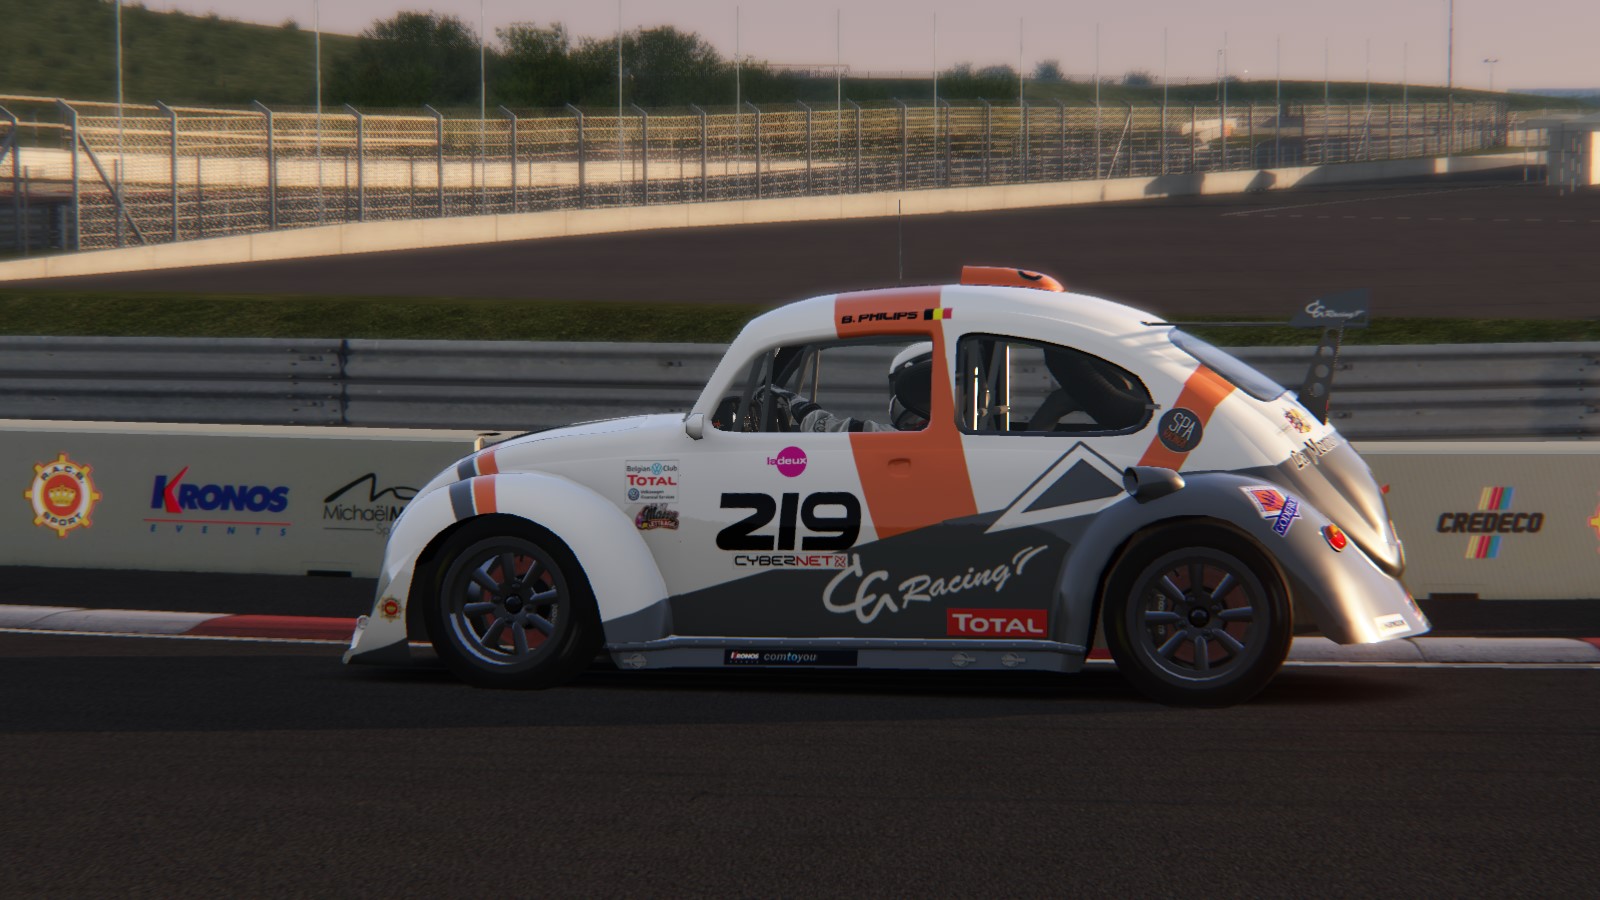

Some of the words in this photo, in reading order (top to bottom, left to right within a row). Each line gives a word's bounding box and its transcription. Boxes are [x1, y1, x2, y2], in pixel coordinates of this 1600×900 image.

[841, 315, 856, 324] B.
[858, 311, 918, 323] PHILIPS
[1168, 412, 1196, 441] SPA
[626, 465, 651, 473] Belgian
[663, 464, 677, 472] Club
[626, 474, 677, 486] TOTAL
[150, 466, 290, 514] KRONOS
[43, 511, 83, 527] SPORT
[716, 491, 862, 550] 219
[1437, 512, 1544, 534] CREDECO
[150, 524, 288, 537] EVENTS
[899, 565, 1012, 610] Racing
[951, 613, 1045, 634] TOTAL
[763, 651, 818, 664] comtoyou
